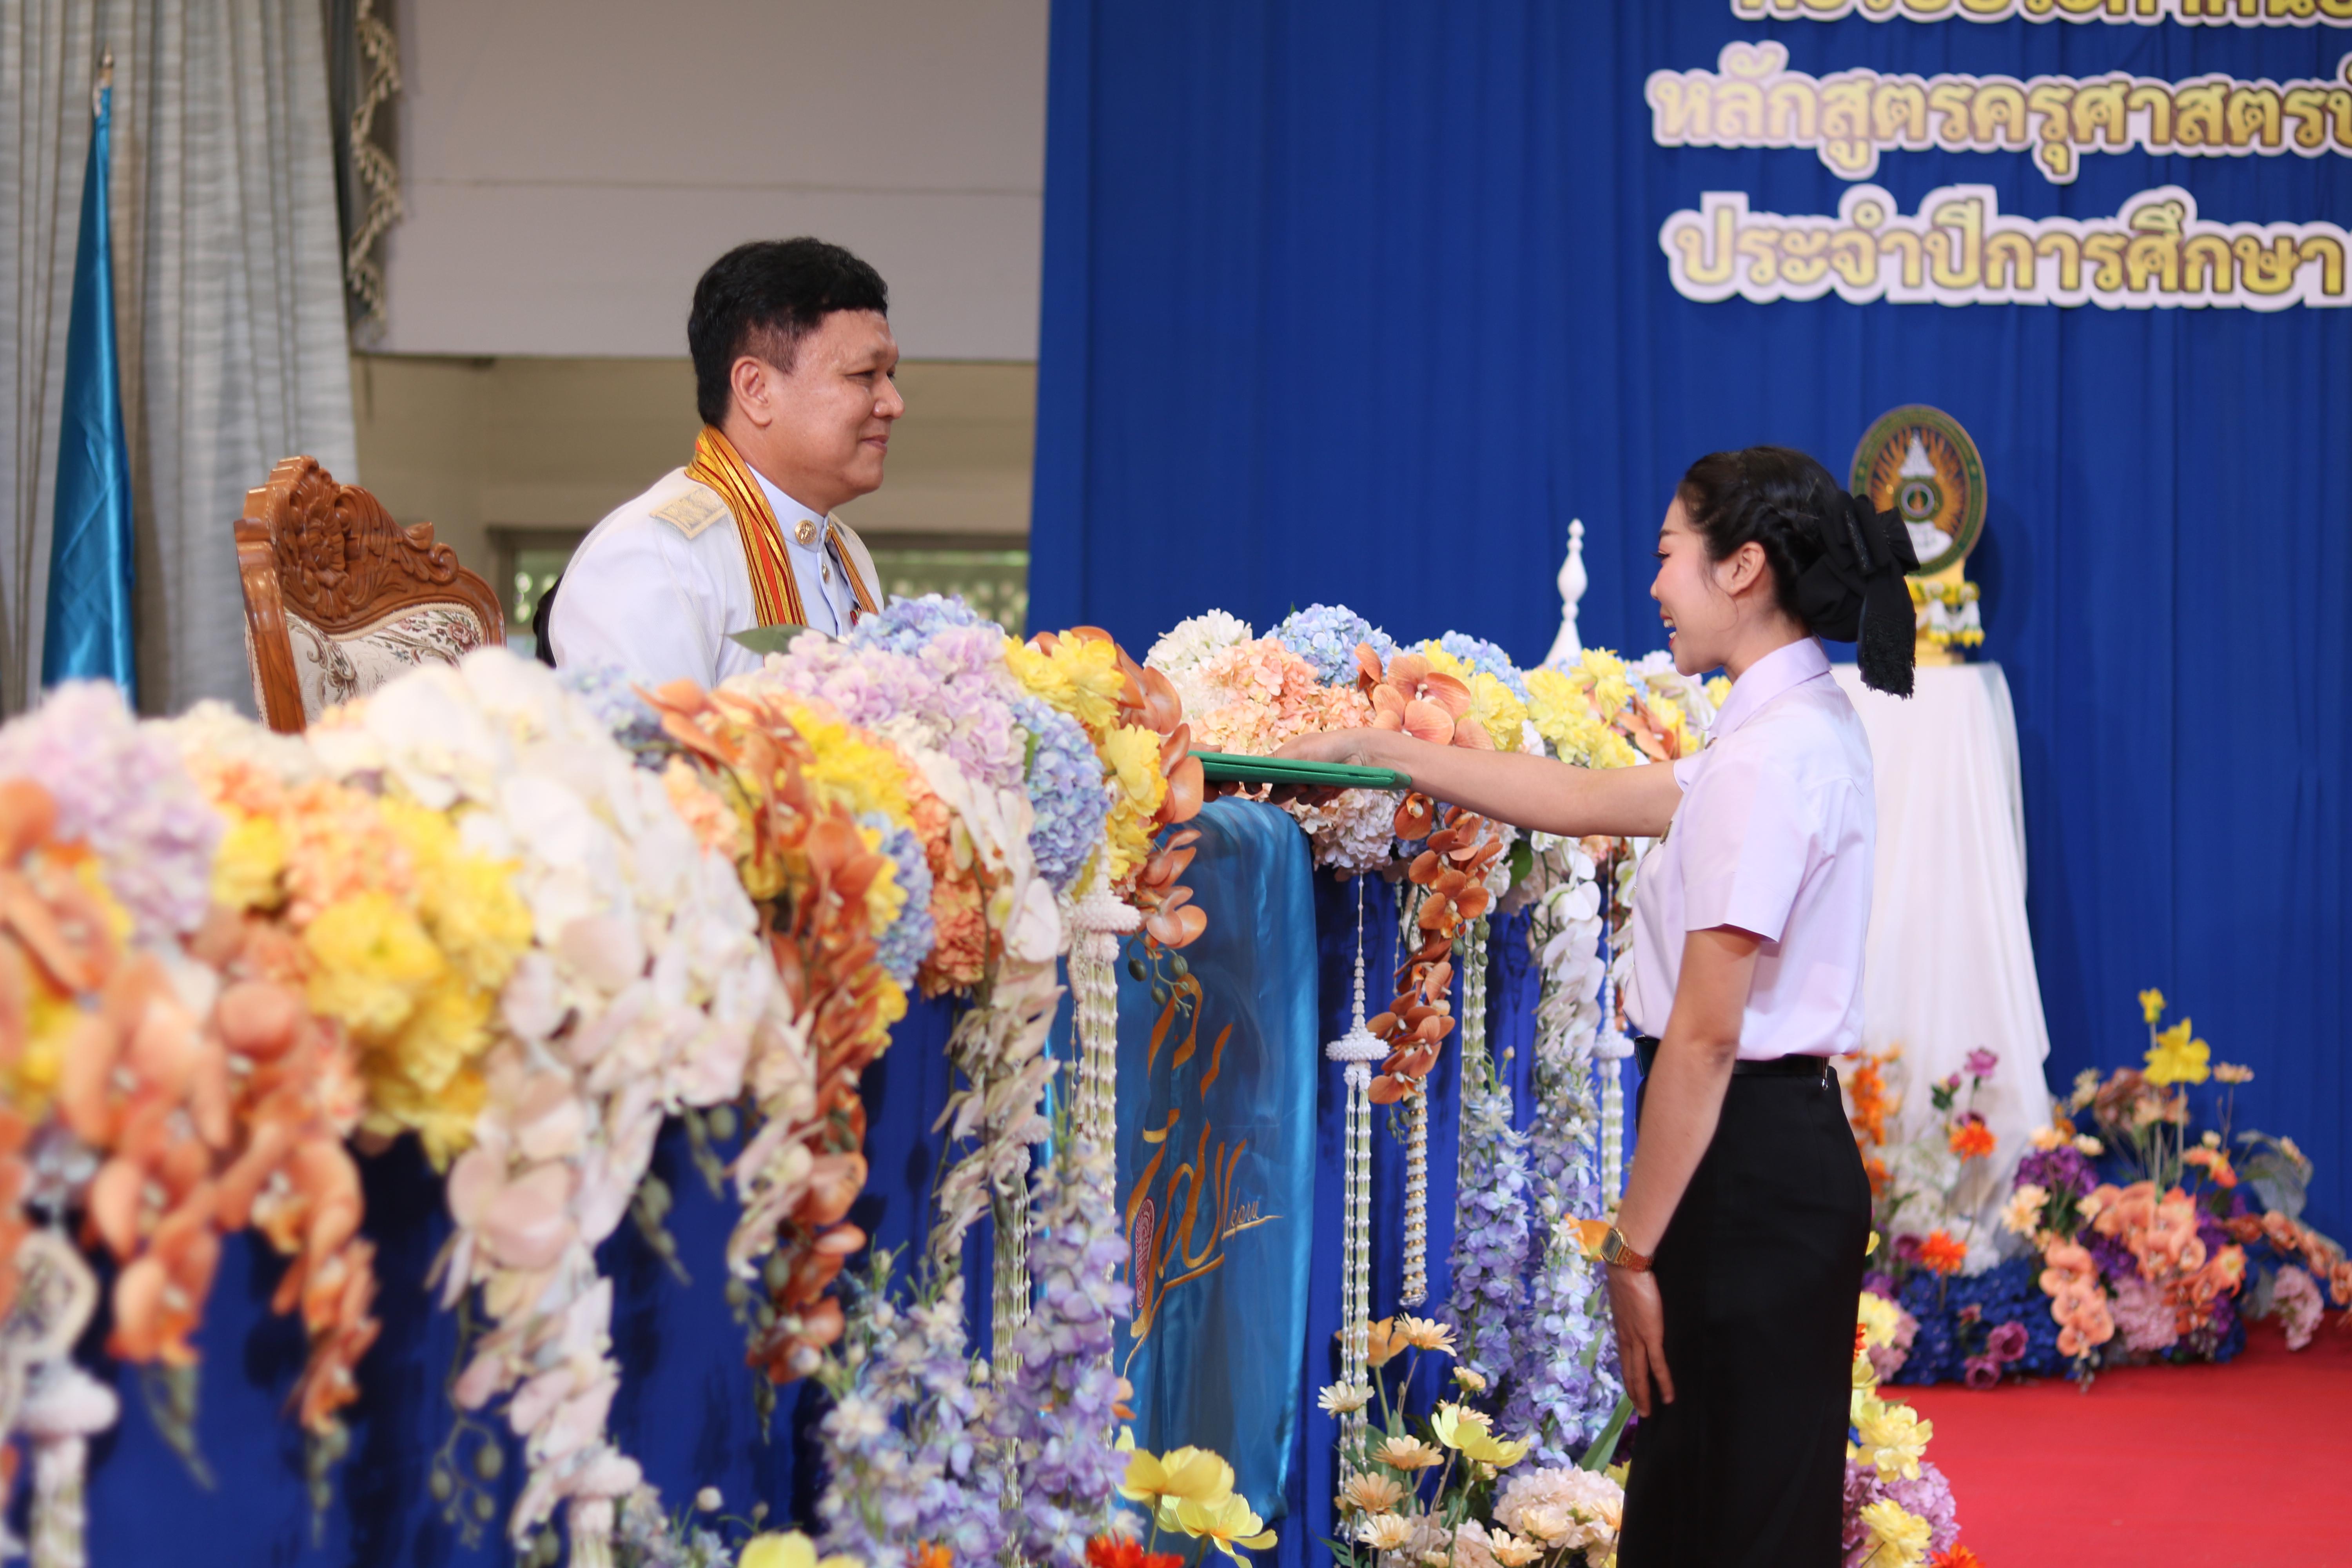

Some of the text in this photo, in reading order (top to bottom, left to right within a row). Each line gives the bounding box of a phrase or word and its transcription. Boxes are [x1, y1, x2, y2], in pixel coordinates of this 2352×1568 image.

[1651, 49, 2352, 176] หลักสูตรครุศาสตร
[1672, 196, 2345, 297] ประจำปีการศึกษา
